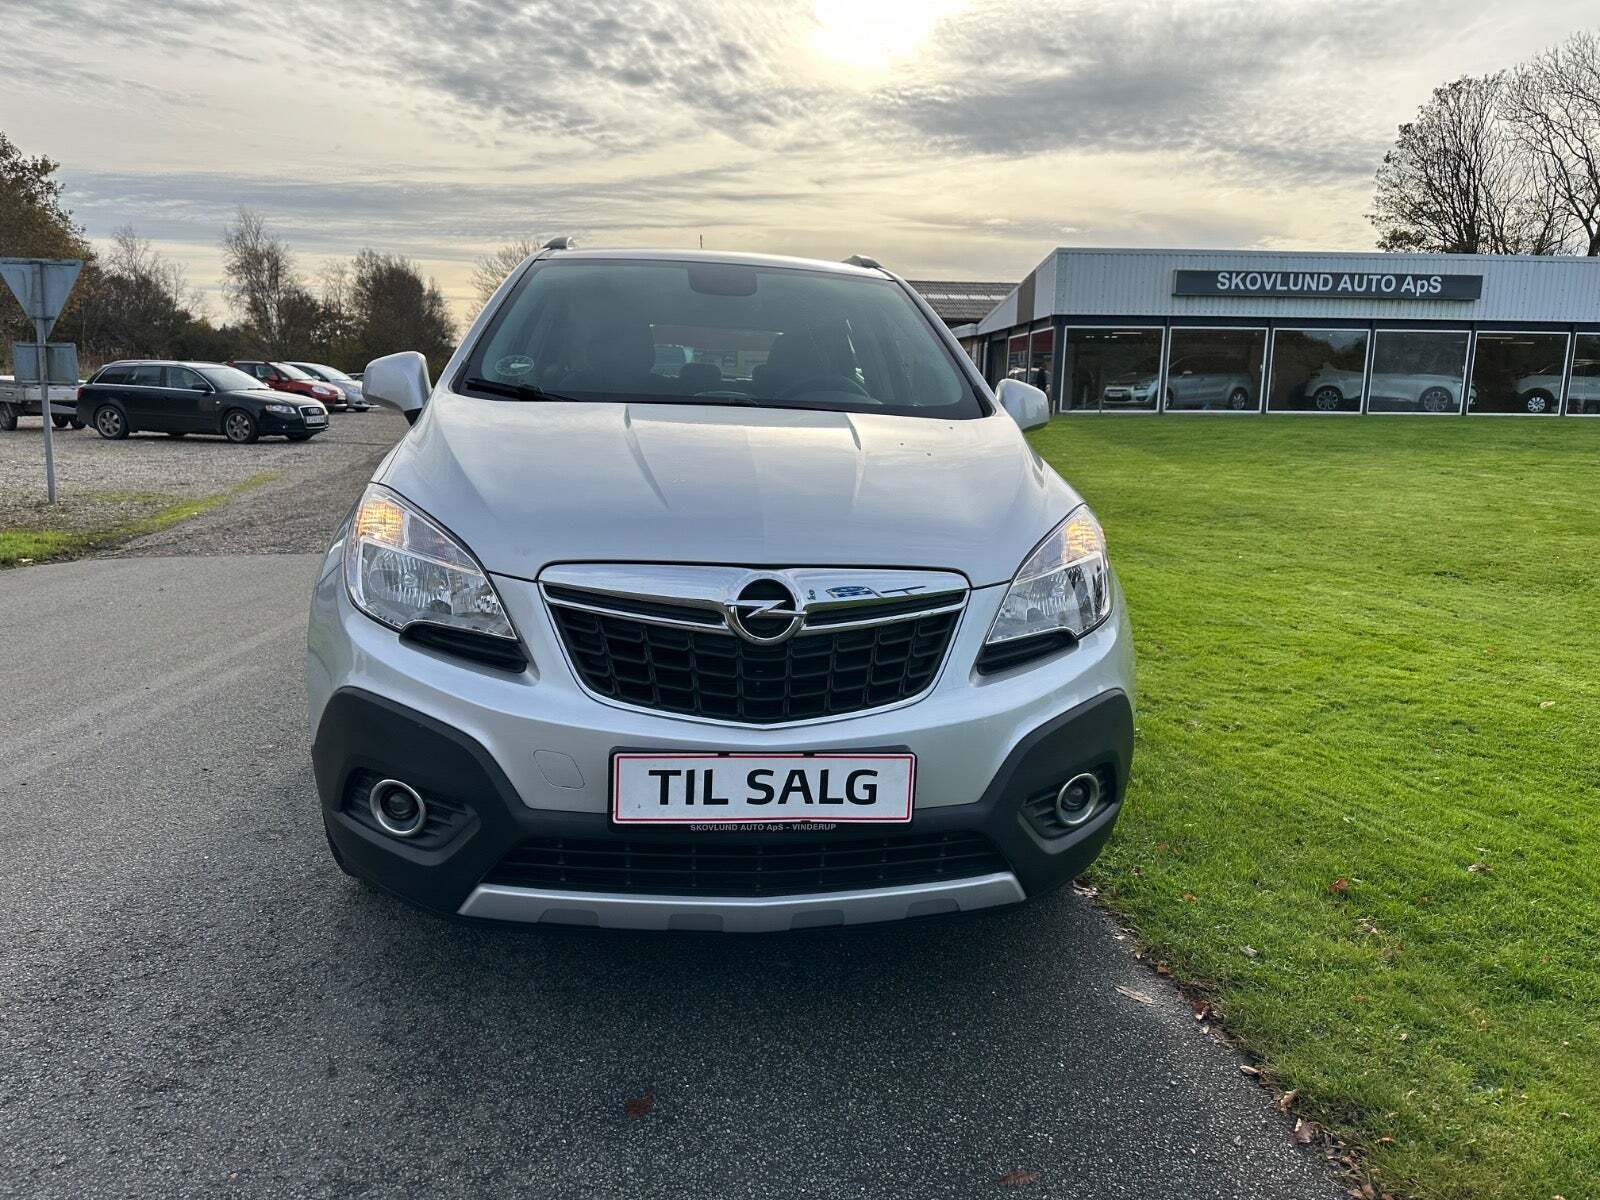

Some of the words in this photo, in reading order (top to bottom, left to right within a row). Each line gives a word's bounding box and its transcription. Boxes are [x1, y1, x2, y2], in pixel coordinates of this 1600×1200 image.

[1216, 272, 1333, 292] SKOVLUND
[1337, 274, 1397, 293] AUTO
[1400, 275, 1443, 297] ApS
[648, 769, 729, 806] TIL
[746, 768, 879, 806] SALG
[690, 824, 738, 832] SKOVLUND
[740, 823, 764, 832] AUTO
[766, 823, 784, 832] ApS
[792, 823, 837, 831] VINDERUP
